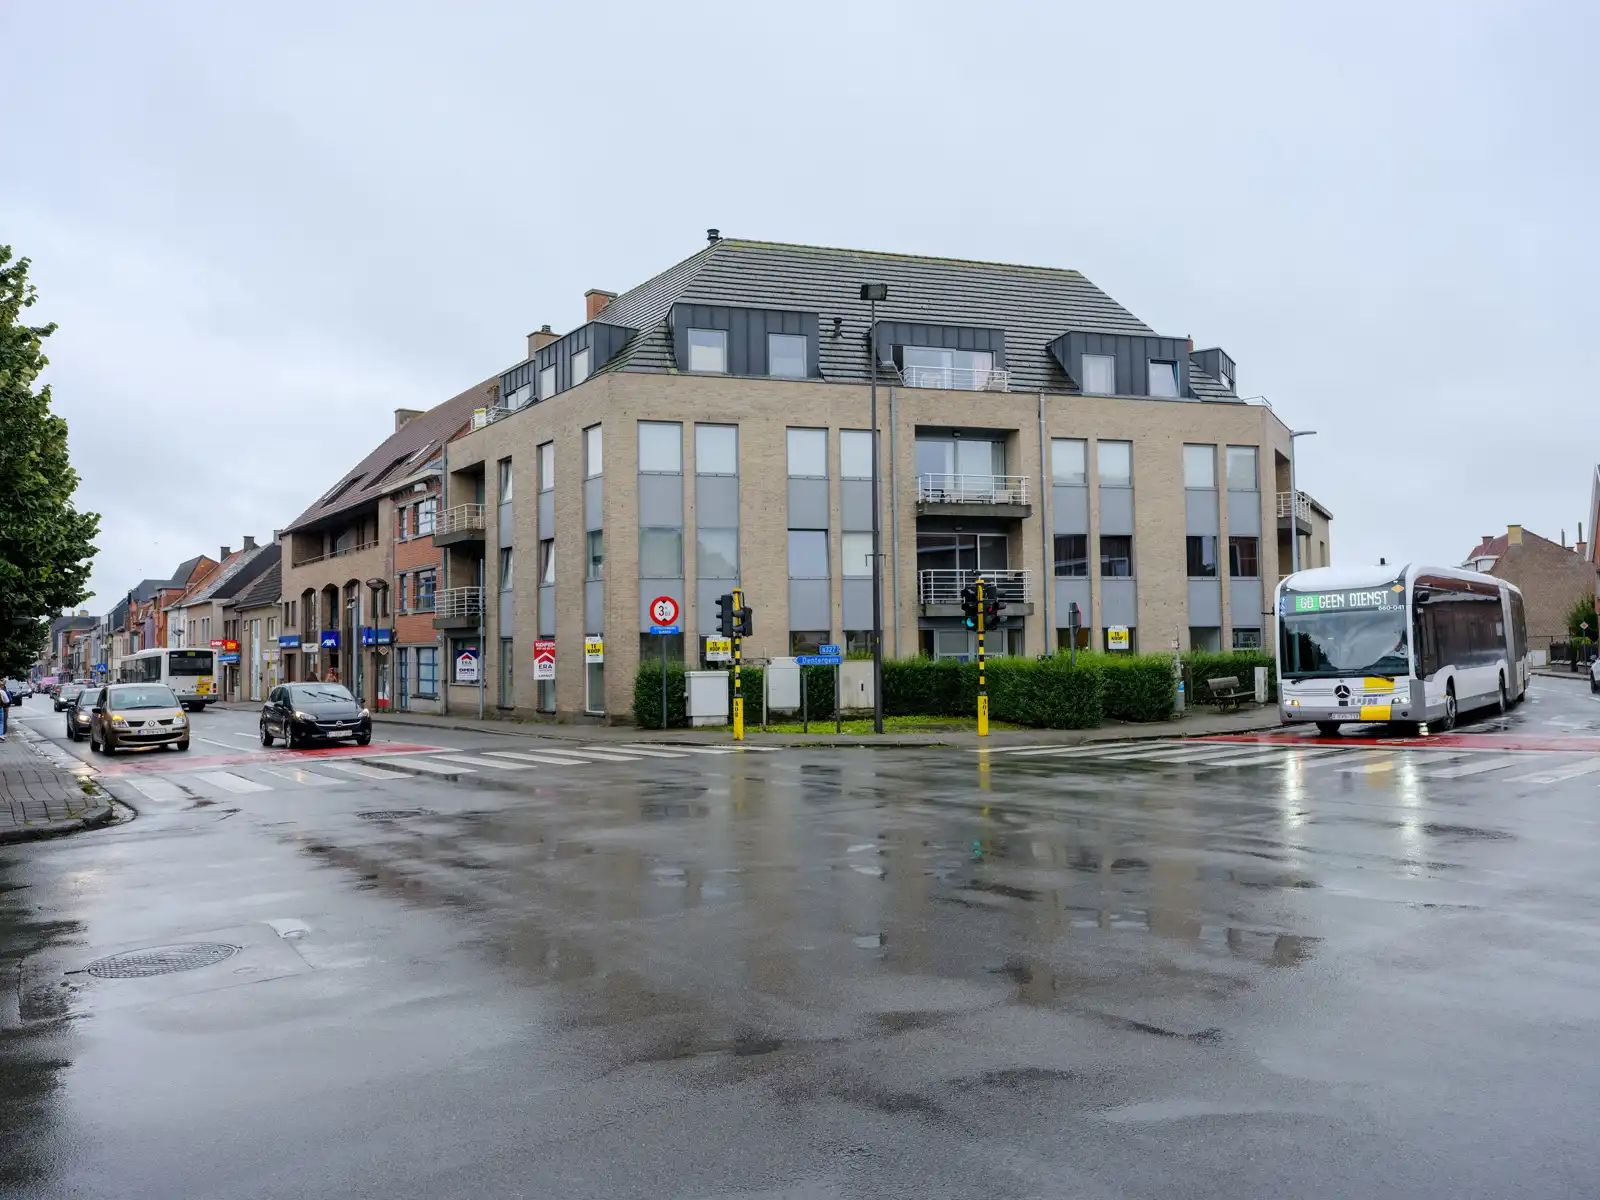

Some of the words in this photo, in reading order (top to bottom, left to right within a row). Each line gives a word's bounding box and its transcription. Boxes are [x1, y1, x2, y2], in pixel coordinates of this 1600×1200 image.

[1319, 594, 1345, 608] GEEN
[1350, 590, 1388, 606] DIENST
[658, 605, 665, 617] 3
[802, 657, 839, 665] Dentergem
